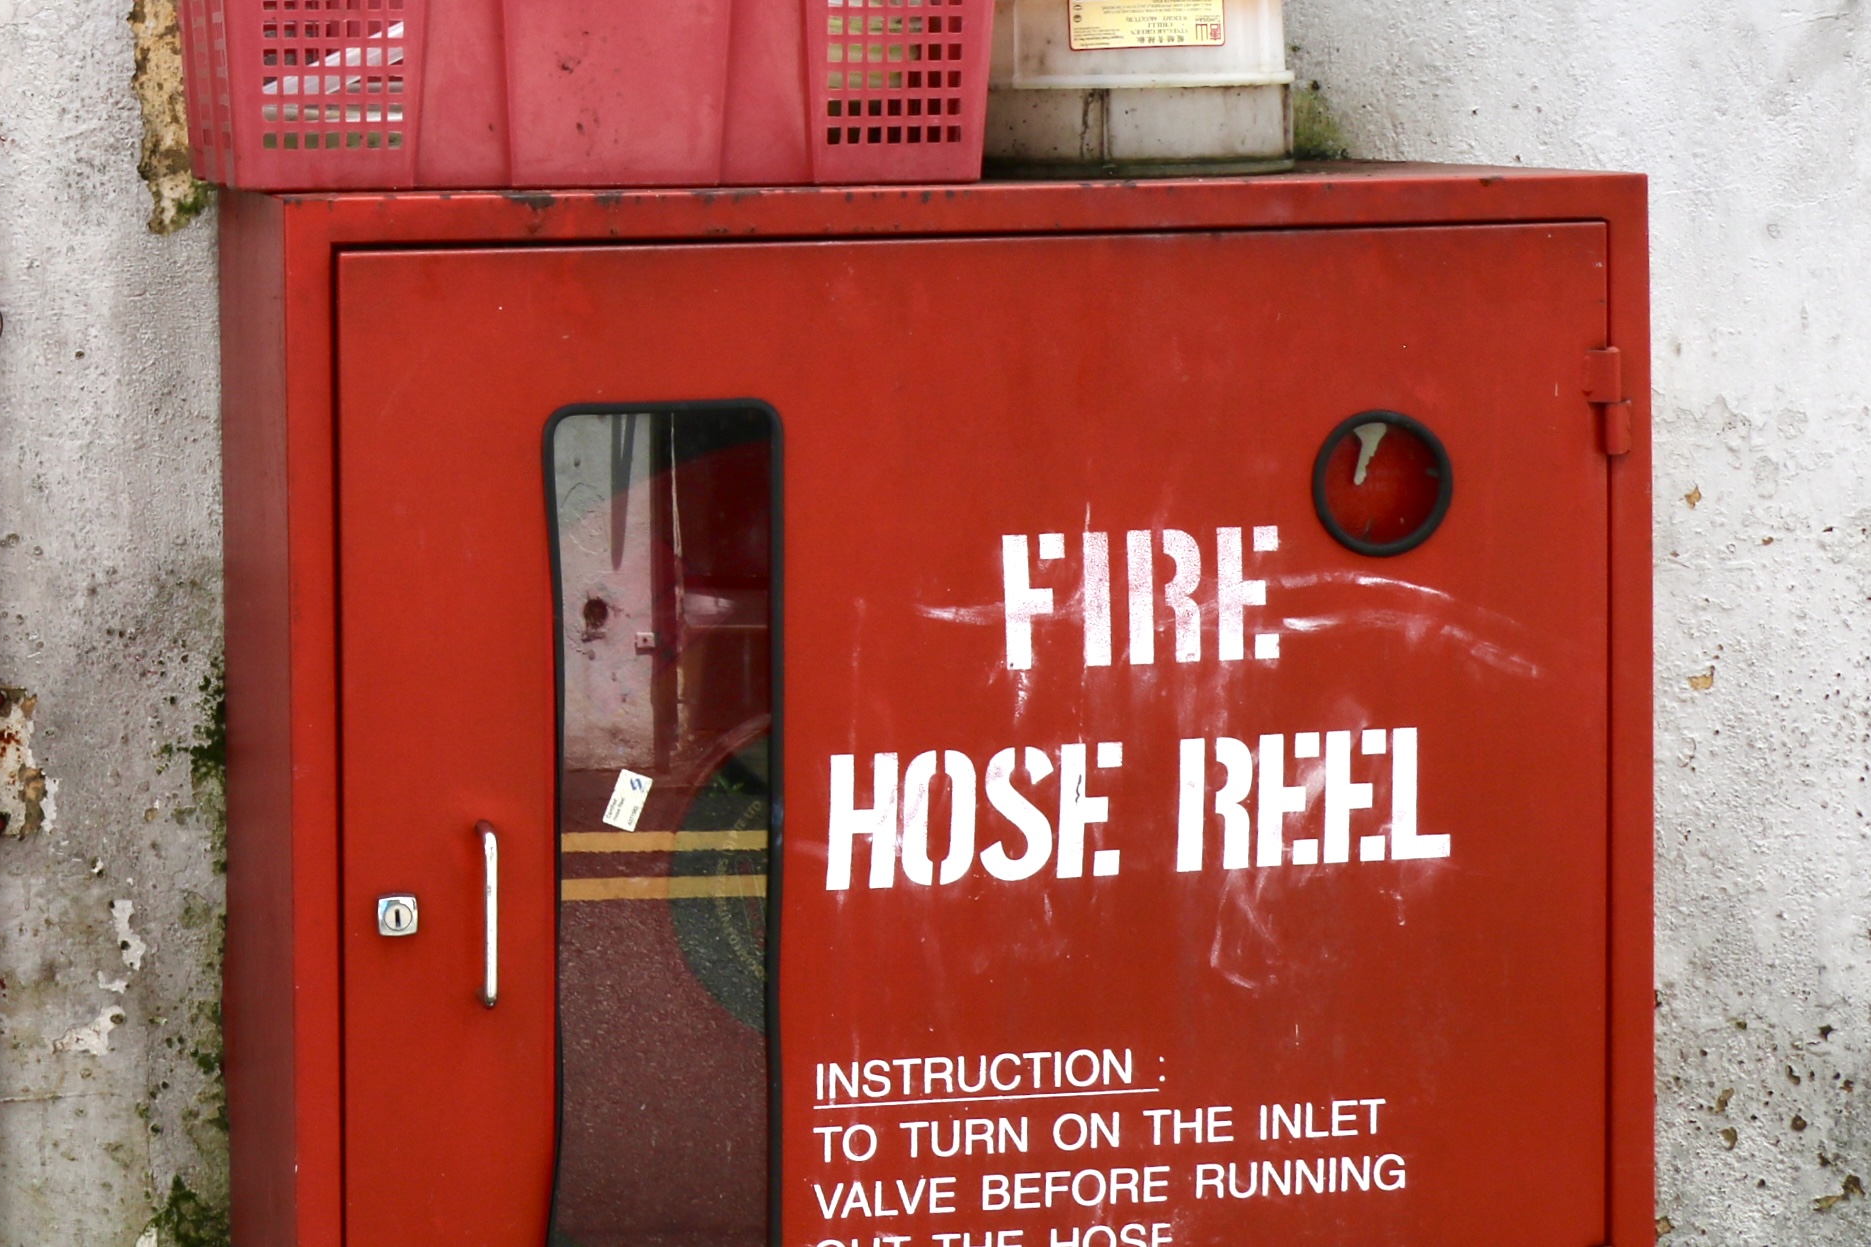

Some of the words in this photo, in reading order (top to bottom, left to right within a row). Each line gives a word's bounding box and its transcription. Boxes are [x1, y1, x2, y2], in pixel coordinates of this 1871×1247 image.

[1001, 525, 1281, 671] FIRE
[825, 740, 1124, 891] HOSE
[1175, 726, 1452, 874] REEL
[815, 1048, 1133, 1102] INSTRUCTION
[812, 1123, 878, 1163] TO
[899, 1116, 1028, 1159] TURN
[1052, 1111, 1120, 1151] ON
[1142, 1105, 1234, 1146] THE
[1259, 1098, 1387, 1141] INLET
[813, 1176, 957, 1220] VALVE
[982, 1165, 1171, 1212] BEFORE
[1195, 1153, 1406, 1201] RUNNING
